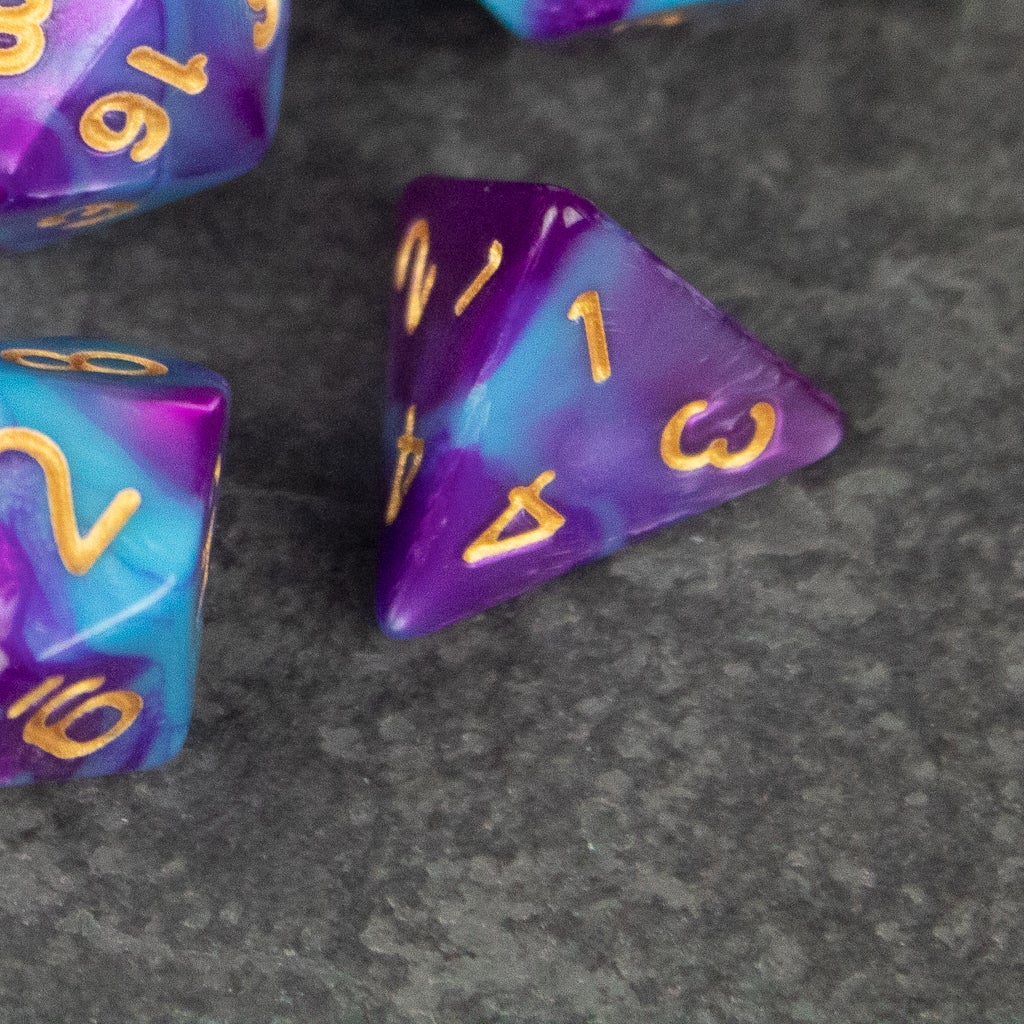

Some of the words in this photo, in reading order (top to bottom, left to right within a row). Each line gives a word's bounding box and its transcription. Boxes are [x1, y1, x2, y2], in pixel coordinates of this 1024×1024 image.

[394, 218, 437, 336] 2
[0, 347, 169, 377] 8
[566, 289, 612, 384] 1
[660, 399, 777, 472] 3
[462, 470, 566, 564] 4
